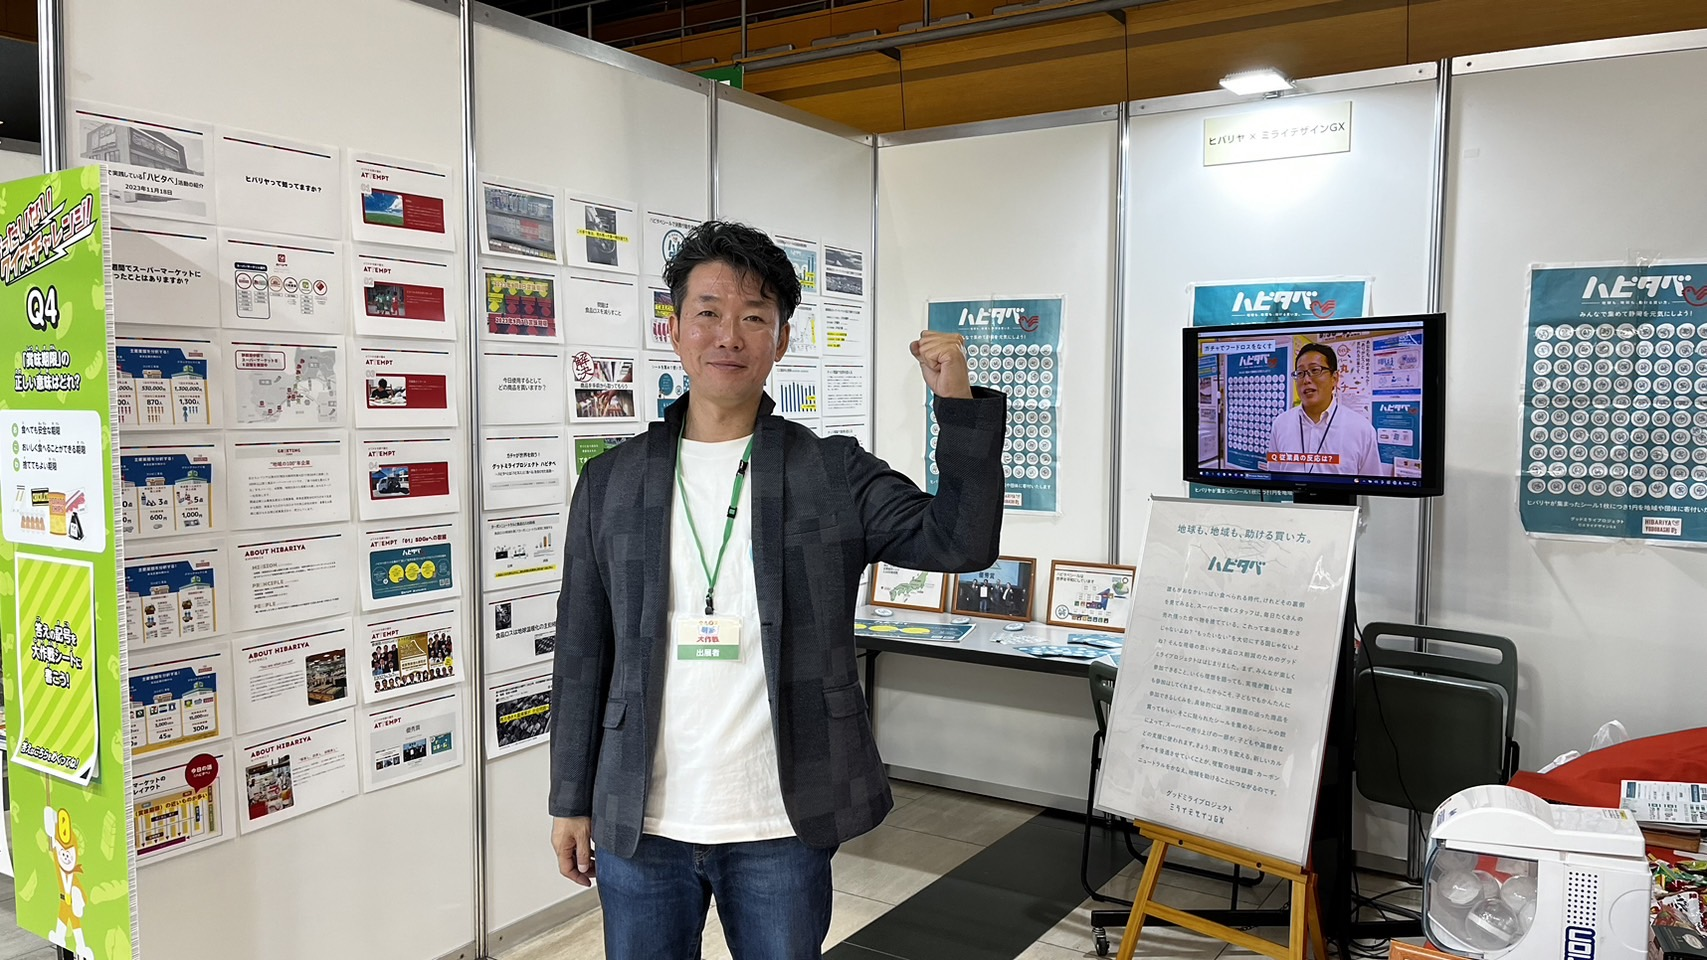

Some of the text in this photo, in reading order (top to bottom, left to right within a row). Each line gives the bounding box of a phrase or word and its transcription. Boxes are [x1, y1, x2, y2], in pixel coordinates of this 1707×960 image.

[1209, 134, 1245, 146] ヒバリヤ
[1261, 122, 1346, 140] ミライデザインGX
[125, 184, 173, 196] 2023年11月18日
[246, 176, 322, 193] ヒバリヤって知ってますか？
[0, 187, 52, 257] ったいない
[1582, 275, 1692, 299] ハピタベ
[26, 285, 60, 332] Q4
[1232, 290, 1318, 312] ハピタベ
[1204, 343, 1272, 351] ガチャでフードロスをなくす
[22, 351, 70, 369] 「賞味期限」の
[14, 374, 81, 392] 正しい意味はどれ？
[1280, 453, 1333, 462] 従業員の反応は？
[1177, 524, 1312, 544] 地球も、地域も、助ける買い方。
[245, 544, 306, 557] ABOUT HIBARIYA
[1208, 556, 1266, 576] ハピタベ
[34, 622, 78, 646] 答えの記号を
[248, 642, 310, 660] ABOUT HIBARIYA
[696, 648, 720, 658] 出展者
[44, 668, 70, 689] 書こう！
[250, 736, 312, 758] ABOUT HIBARIYA
[1166, 790, 1233, 812] グッドミライプロジェクト
